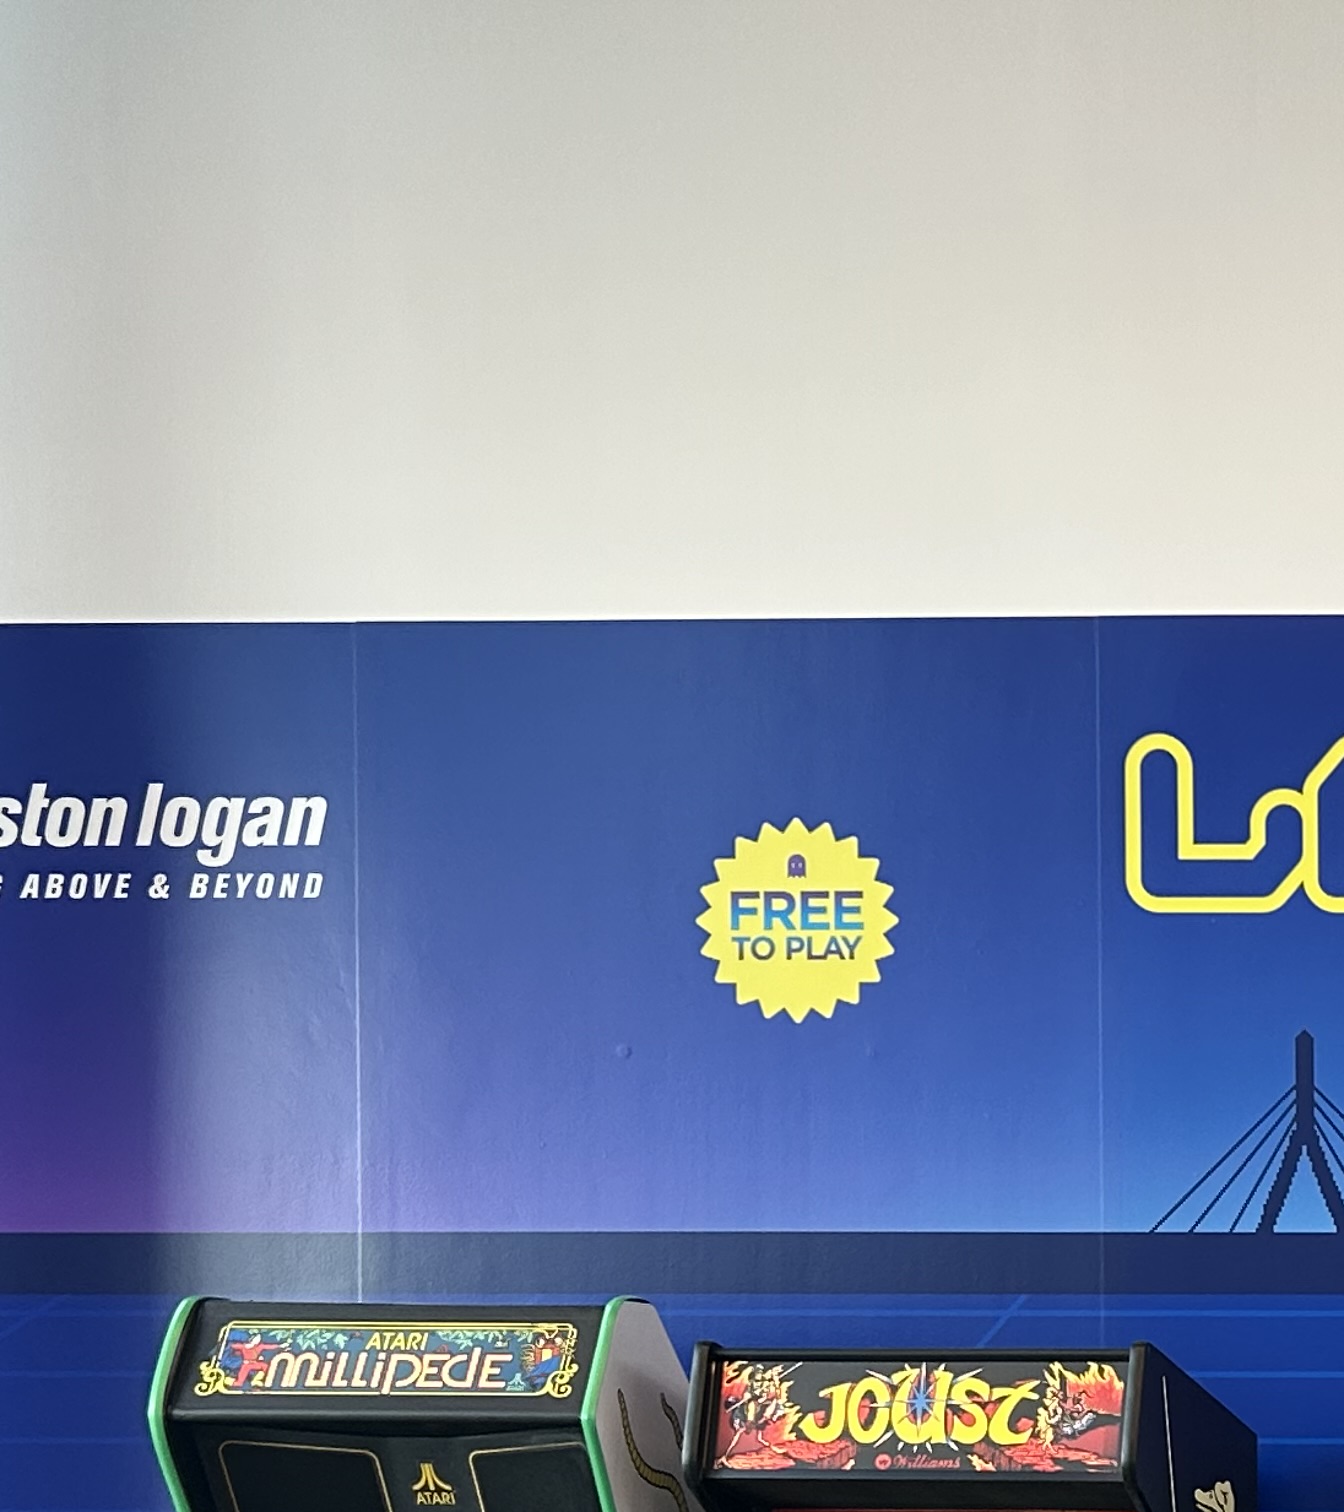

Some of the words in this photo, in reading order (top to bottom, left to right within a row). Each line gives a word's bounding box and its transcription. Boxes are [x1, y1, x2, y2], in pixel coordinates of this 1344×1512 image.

[136, 783, 328, 867] logan
[19, 872, 132, 899] ABOVE
[148, 873, 171, 899] &
[189, 872, 324, 899] BEYOND
[730, 890, 864, 930] FREE
[731, 936, 776, 961] TO
[786, 936, 862, 960] PLAY
[365, 1331, 429, 1350] ATARI
[799, 1367, 1040, 1445] JOUST
[893, 1454, 961, 1469] Williams
[416, 1490, 456, 1506] ATARI
